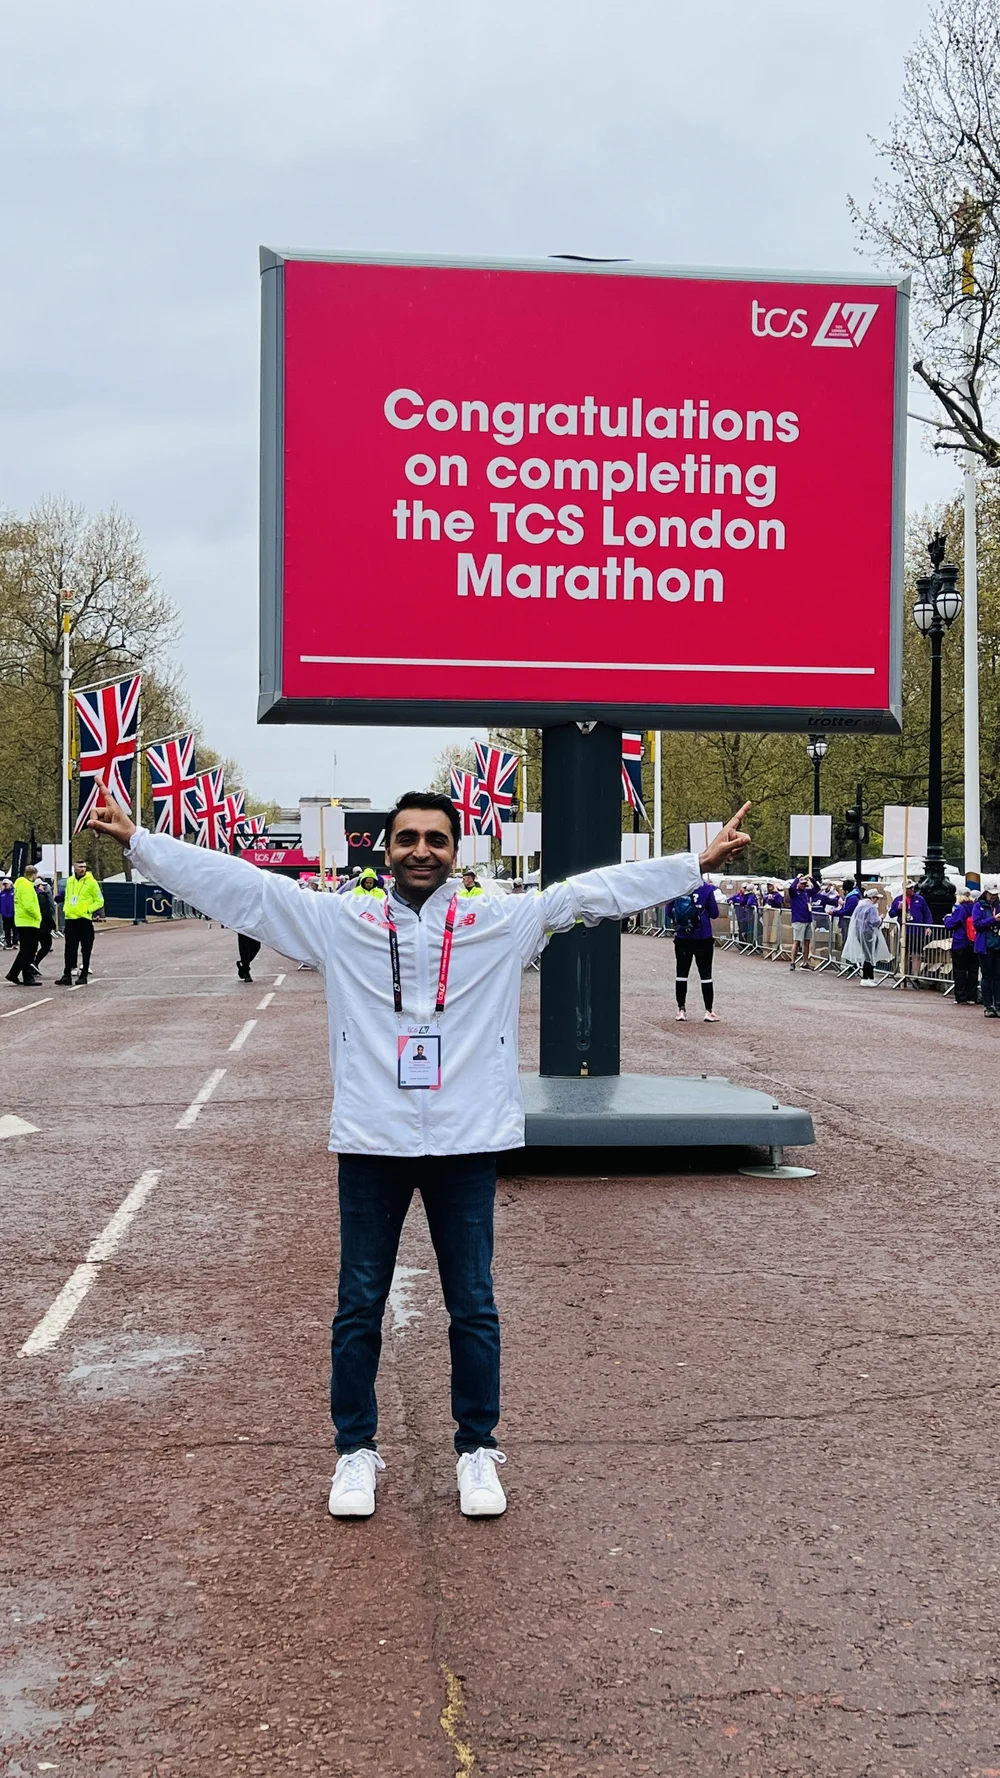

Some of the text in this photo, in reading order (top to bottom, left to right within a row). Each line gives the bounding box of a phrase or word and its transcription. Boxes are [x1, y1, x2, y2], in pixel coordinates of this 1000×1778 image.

[752, 299, 808, 338] tcs
[383, 388, 800, 446] Congratulations
[404, 453, 777, 508] on completing
[393, 499, 786, 550] the TCS London
[457, 552, 724, 603] Marathon
[808, 716, 861, 727] trotter
